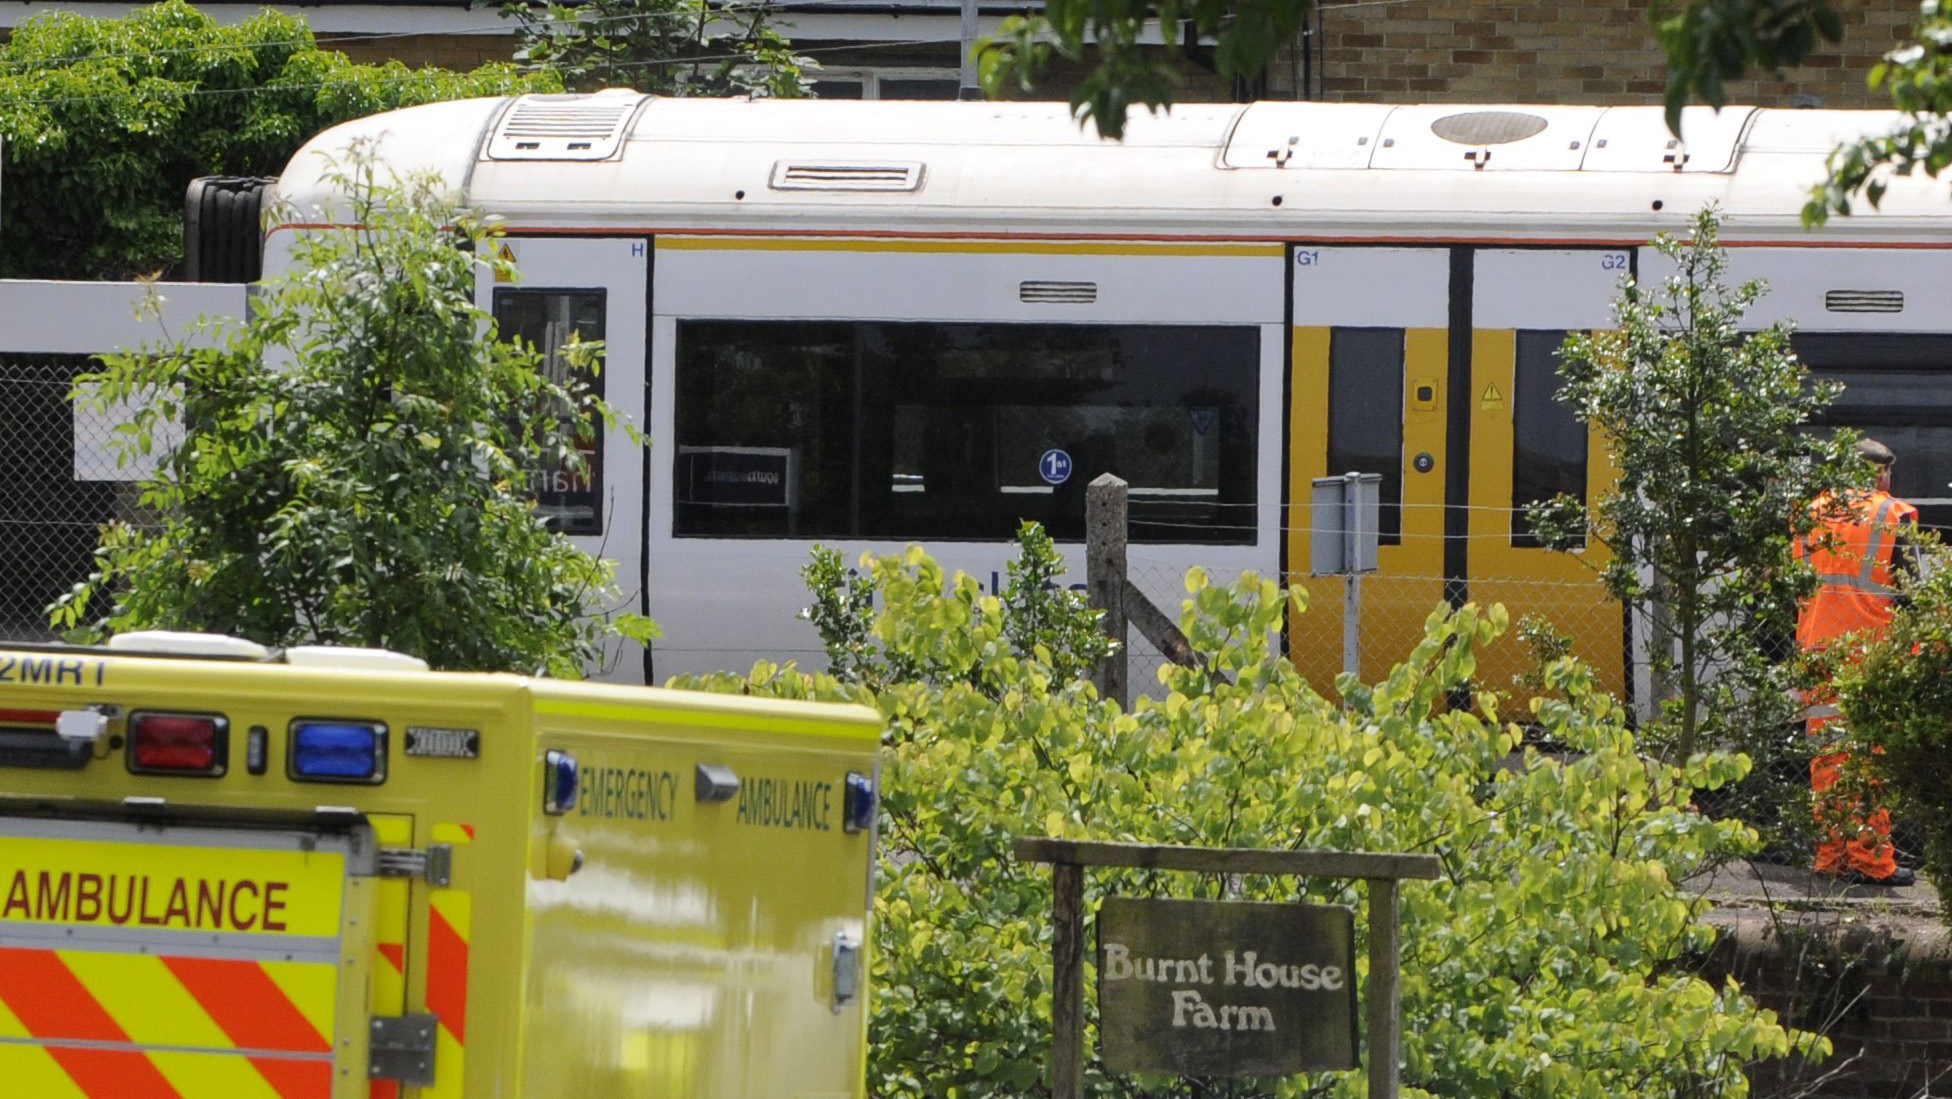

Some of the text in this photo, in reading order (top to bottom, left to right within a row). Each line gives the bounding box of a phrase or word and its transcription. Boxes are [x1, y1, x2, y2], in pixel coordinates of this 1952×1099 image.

[632, 243, 644, 257] H
[1297, 251, 1319, 266] G1
[1602, 254, 1627, 270] G2
[579, 767, 831, 831] EMERGENCY AMBULANCE
[2, 869, 289, 931] AMBULANCE
[1103, 943, 1344, 990] Burnt House
[1171, 989, 1276, 1031] Farm
